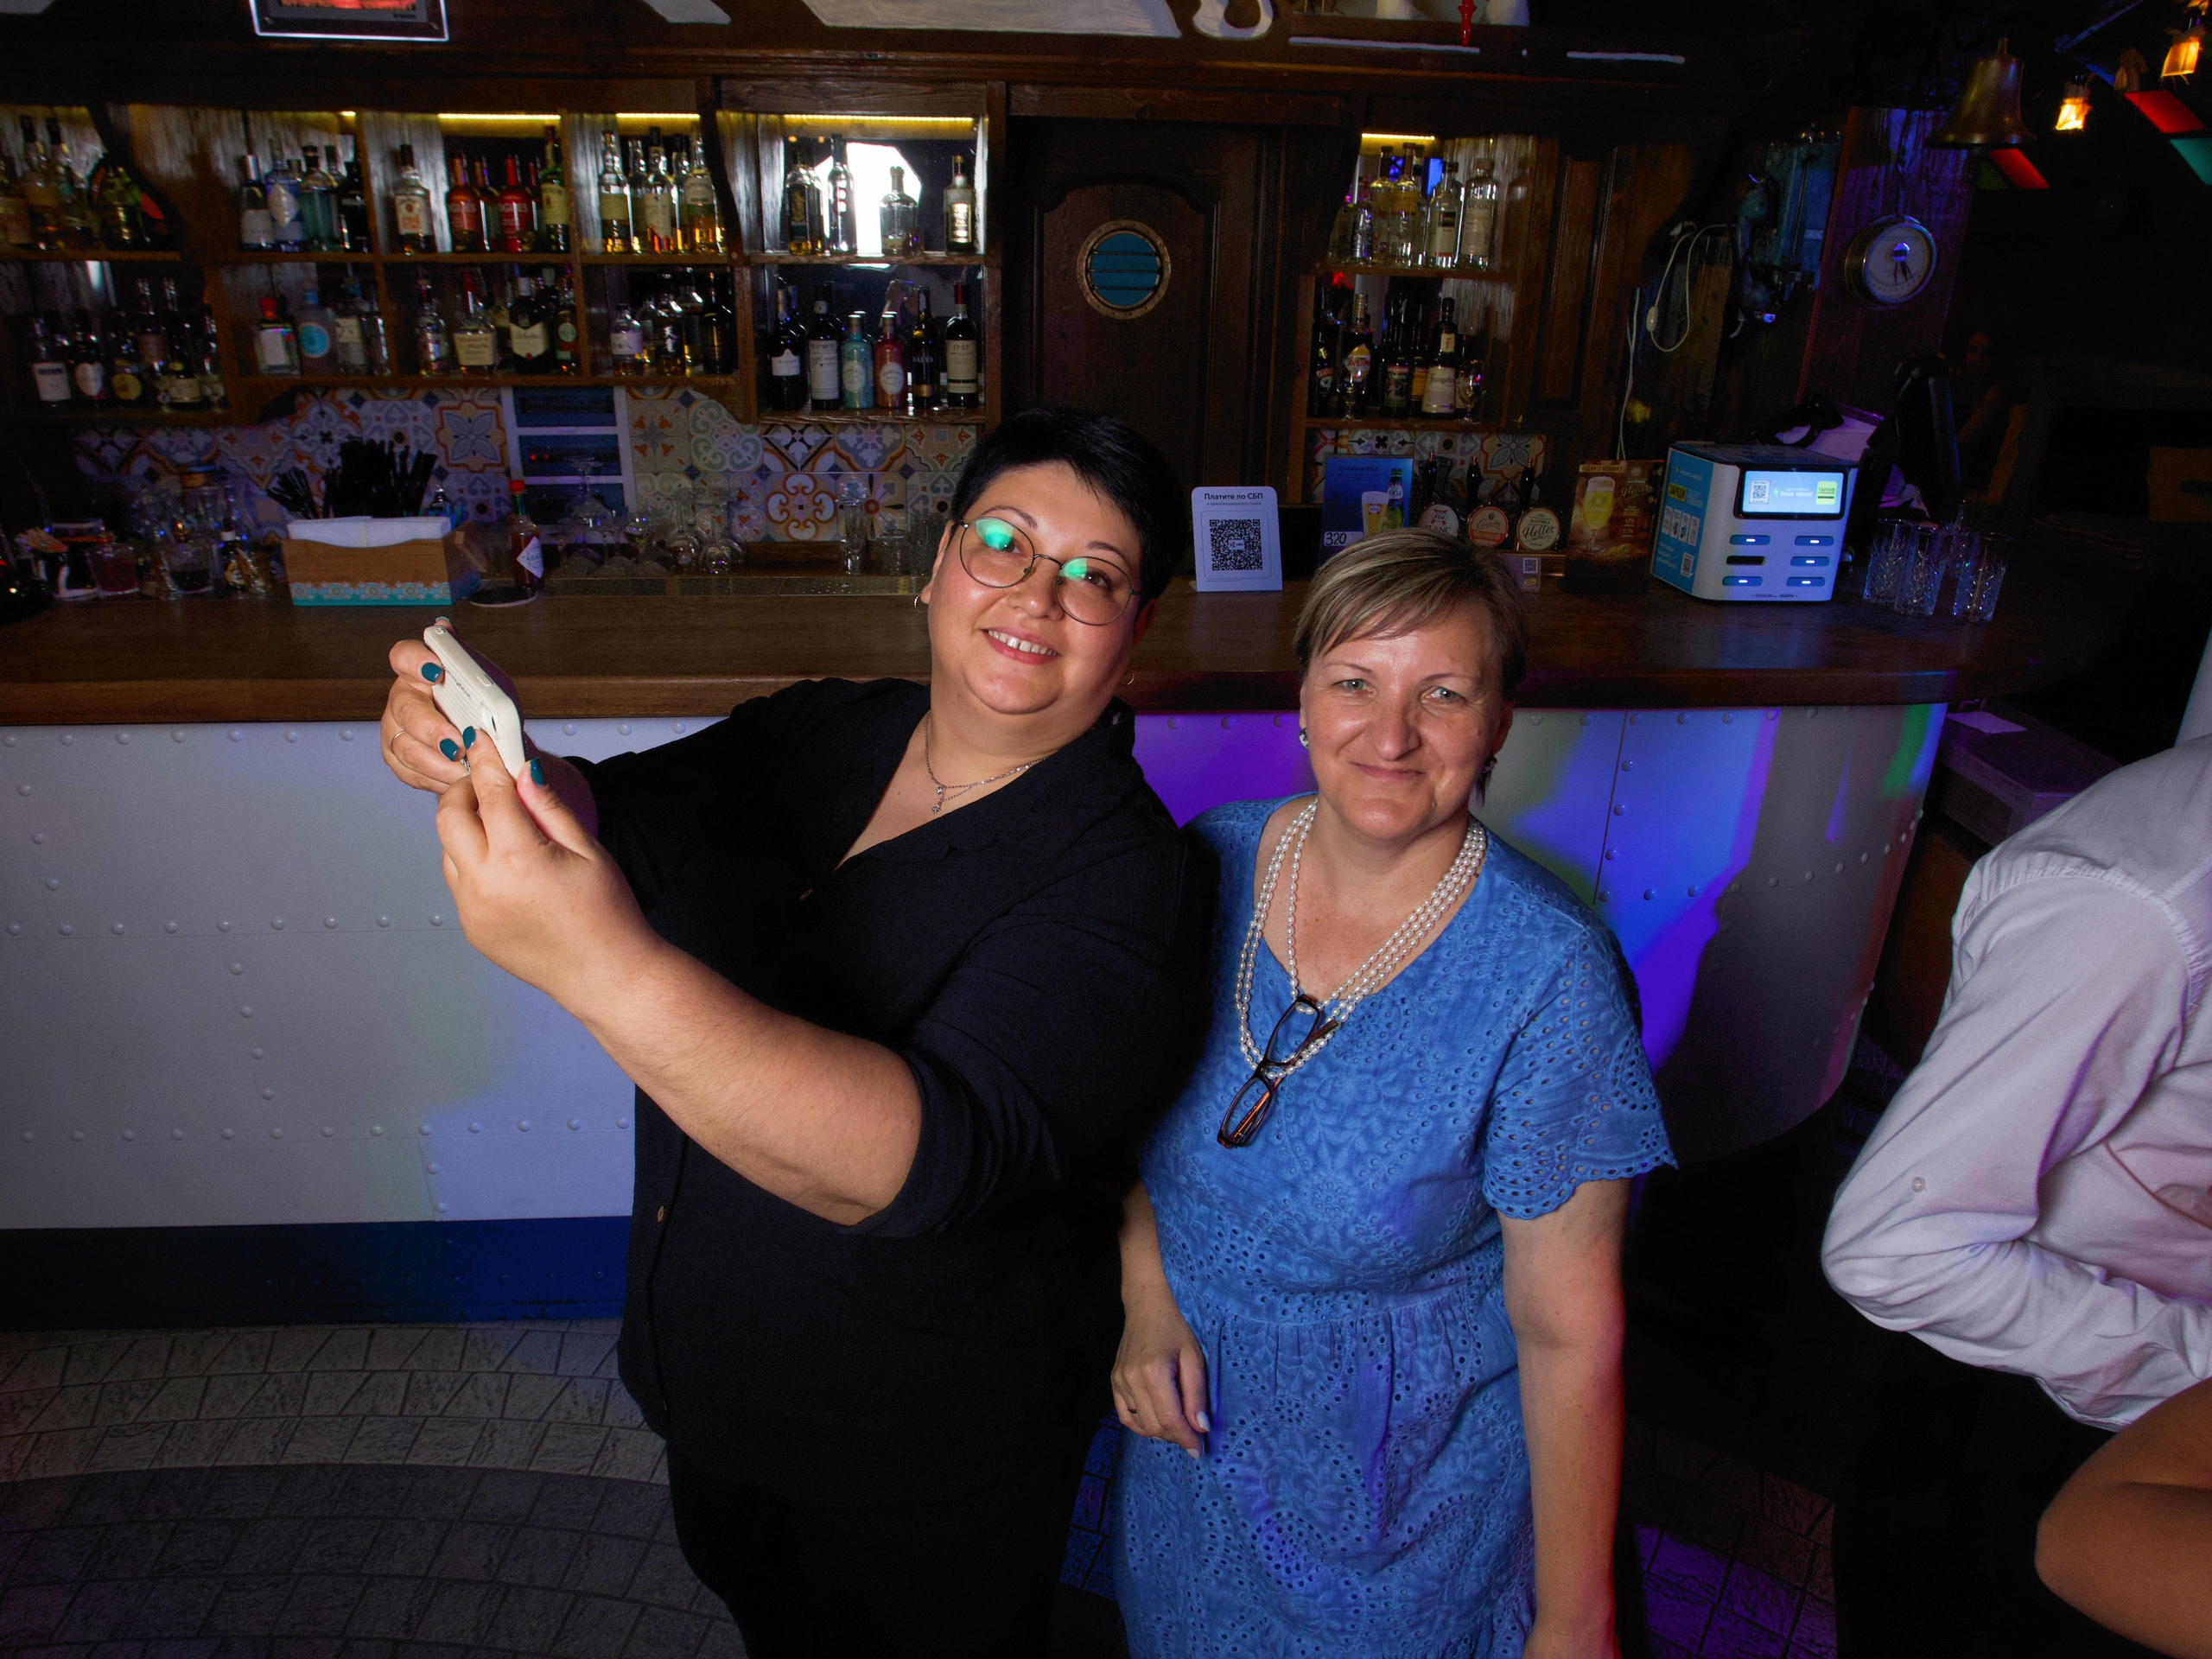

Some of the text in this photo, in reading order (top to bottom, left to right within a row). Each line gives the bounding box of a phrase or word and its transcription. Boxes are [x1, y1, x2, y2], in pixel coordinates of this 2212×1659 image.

[1347, 359, 1371, 367] AVERN
[1522, 524, 1554, 539] Helles
[1325, 532, 1347, 546] 320
